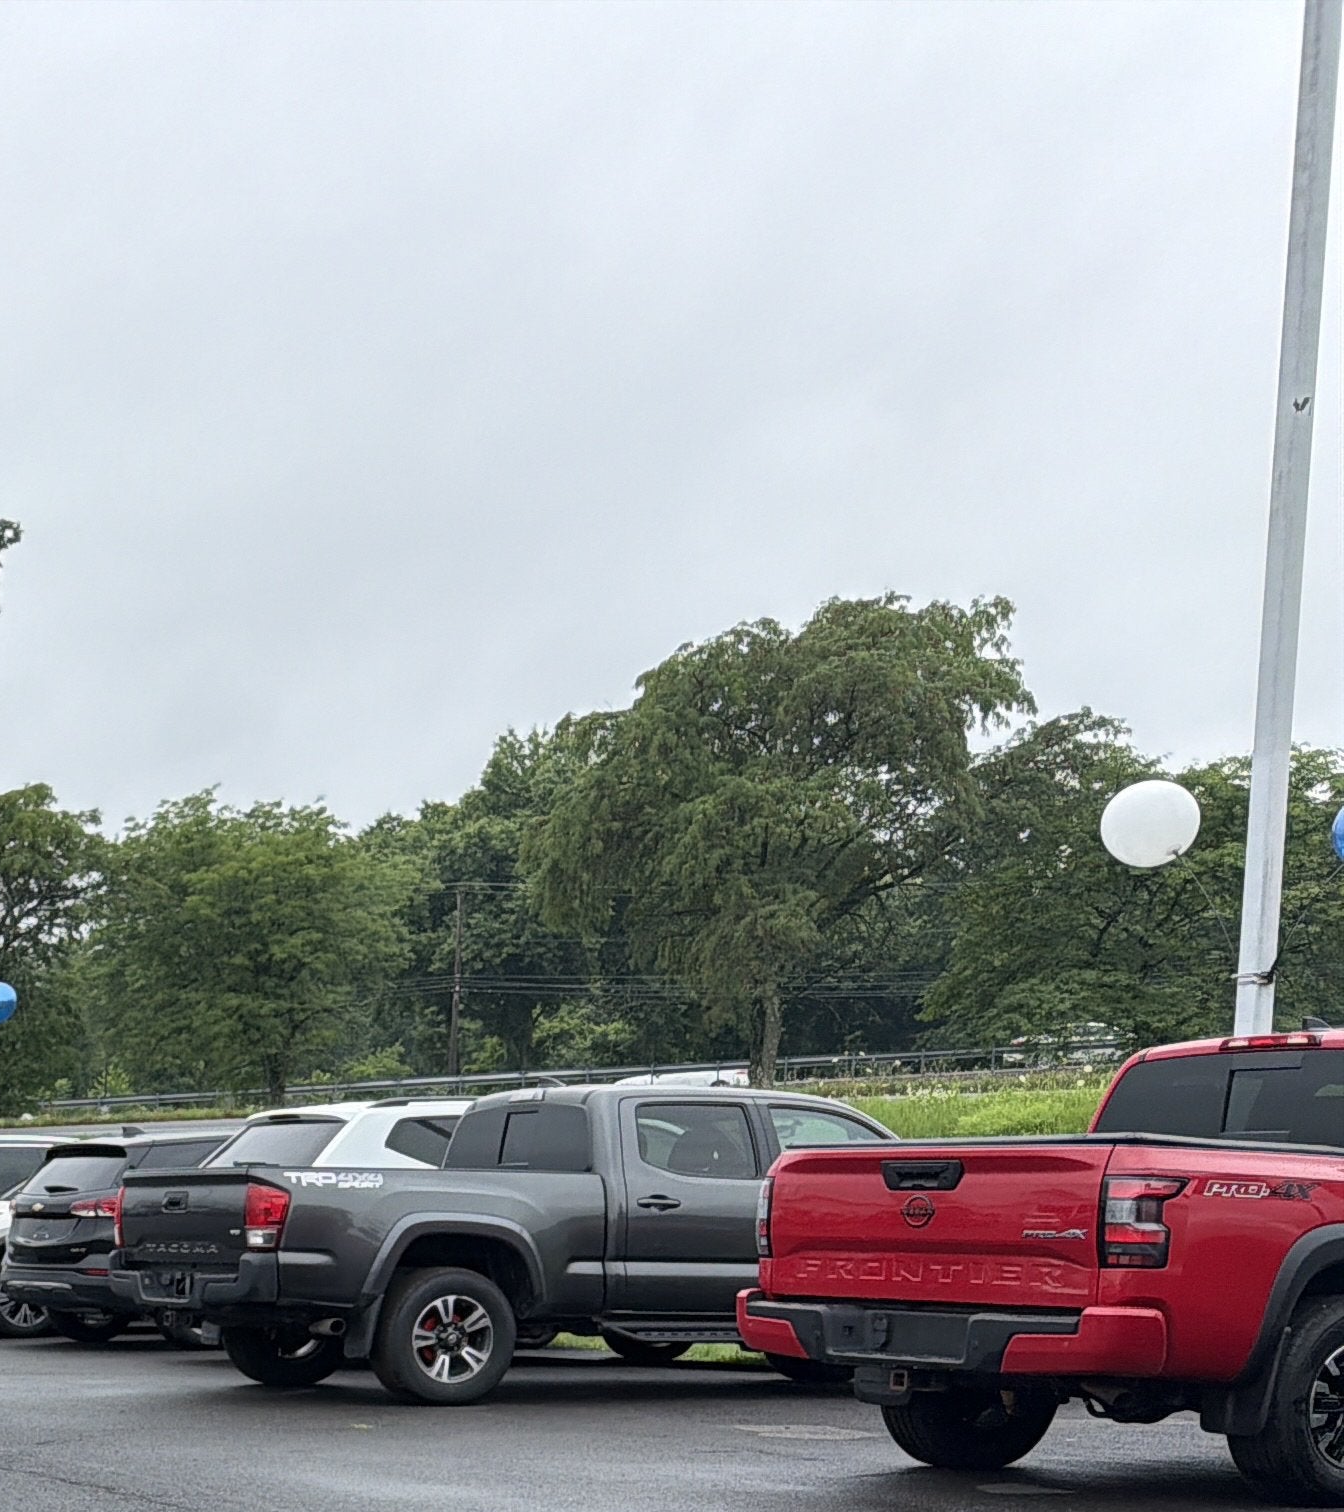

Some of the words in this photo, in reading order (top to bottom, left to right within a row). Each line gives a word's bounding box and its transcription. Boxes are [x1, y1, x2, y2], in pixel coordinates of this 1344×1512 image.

[283, 1171, 337, 1187] TRD
[145, 1242, 219, 1254] TACOMA
[796, 1258, 1064, 1288] FRONTIER
